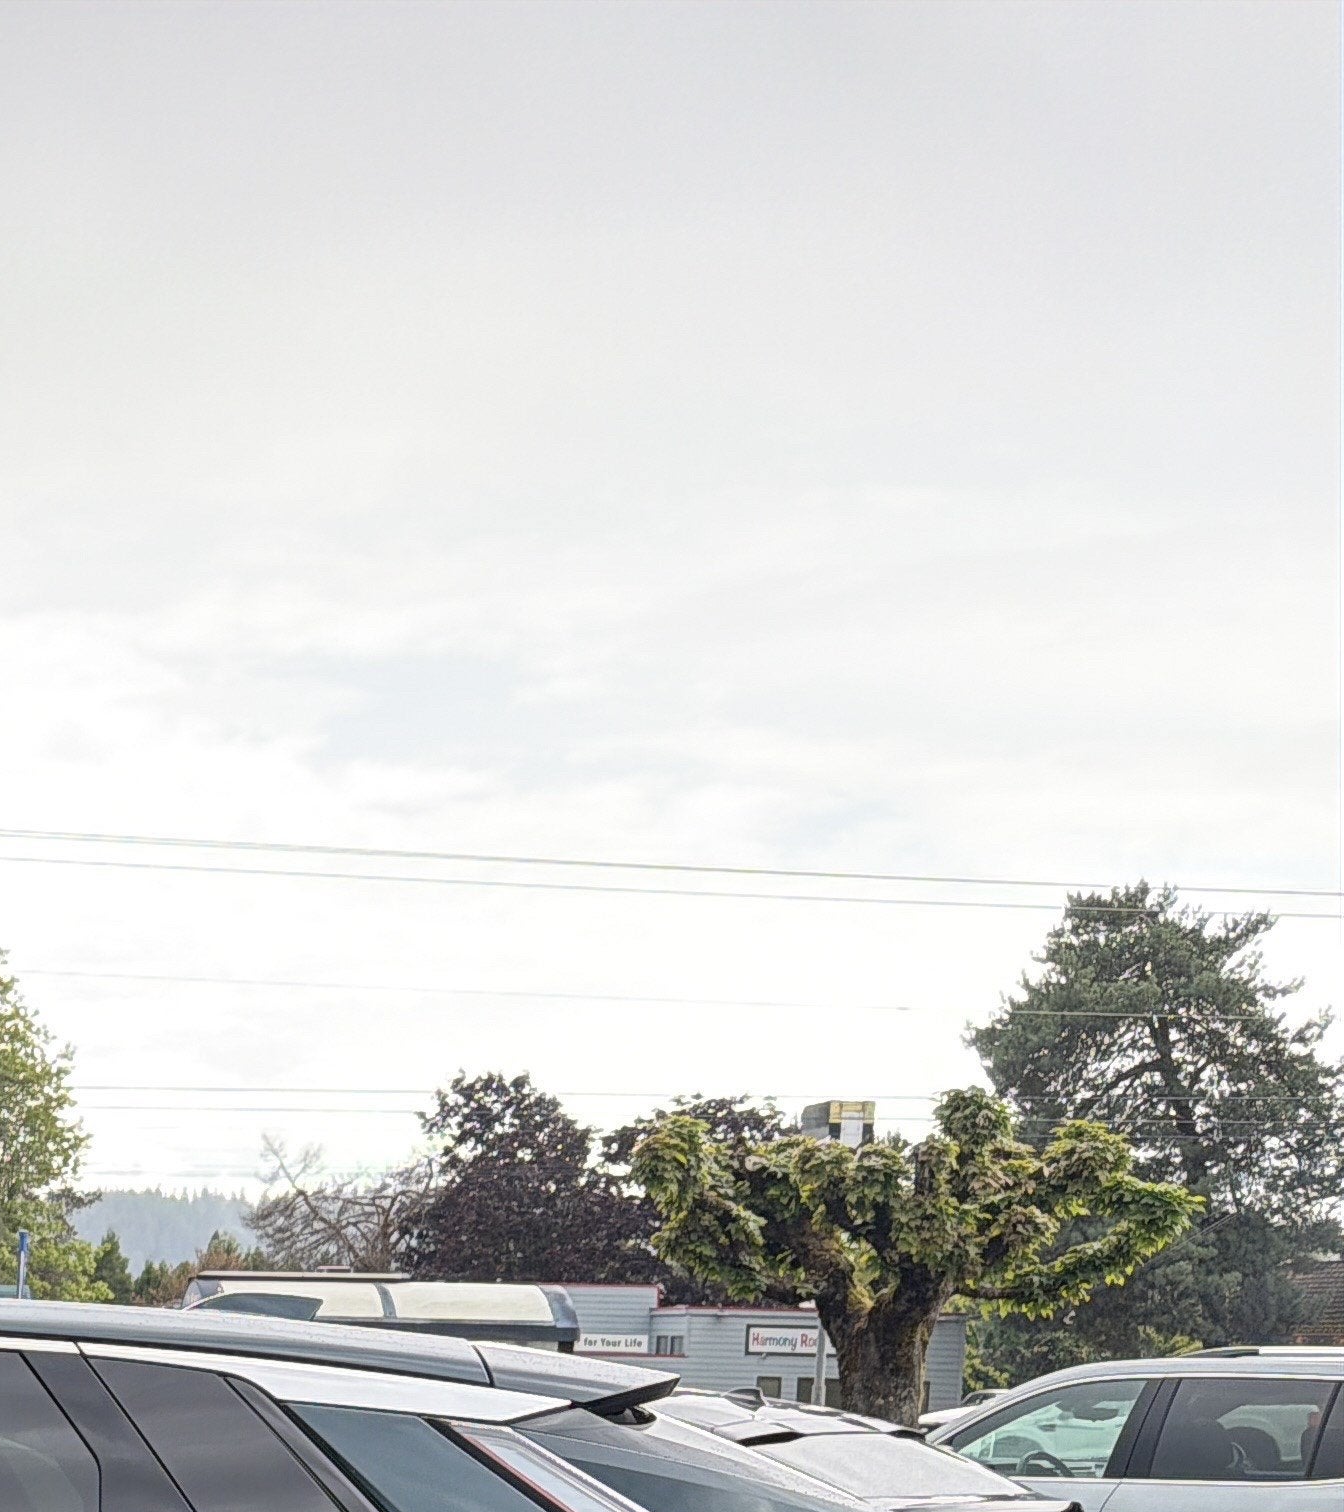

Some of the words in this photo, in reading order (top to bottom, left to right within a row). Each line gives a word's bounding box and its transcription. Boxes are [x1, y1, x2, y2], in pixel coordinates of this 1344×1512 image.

[583, 1336, 598, 1347] for
[600, 1337, 622, 1348] Your
[624, 1338, 643, 1348] Life
[752, 1331, 798, 1351] Harmony
